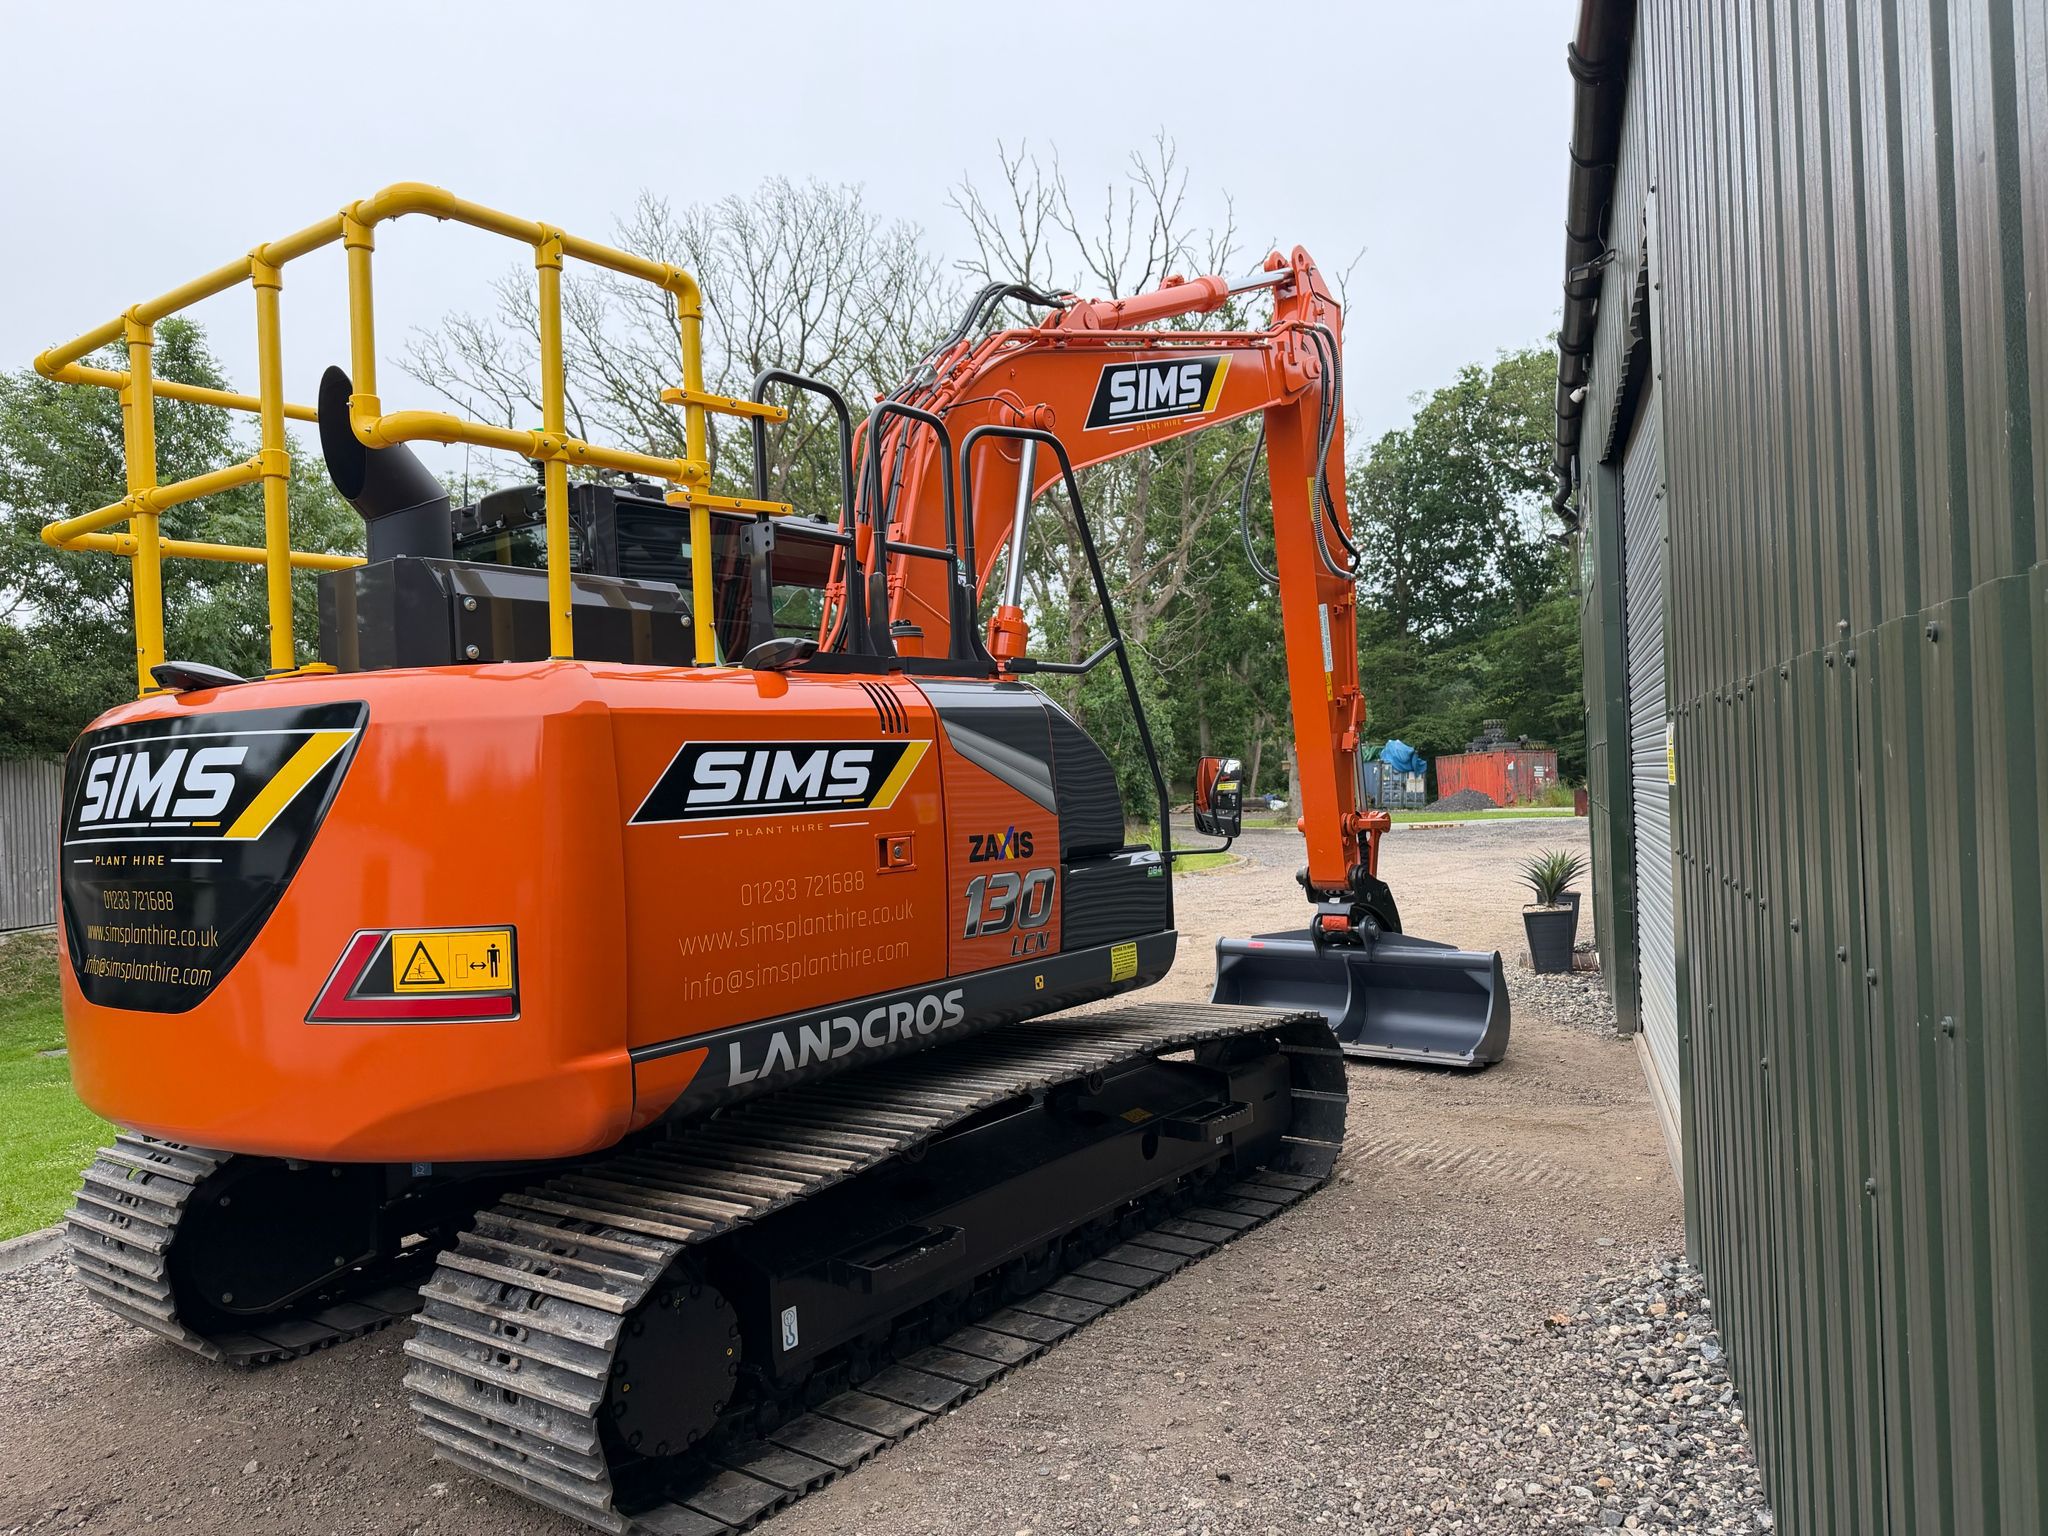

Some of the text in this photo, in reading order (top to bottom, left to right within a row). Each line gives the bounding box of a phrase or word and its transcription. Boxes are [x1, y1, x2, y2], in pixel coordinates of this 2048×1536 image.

[1109, 363, 1202, 414] SIMS
[1136, 418, 1182, 432] PLANT HIRE
[79, 746, 248, 823] SIMS
[686, 749, 874, 804] SIMS
[735, 823, 824, 837] PLANT HIRE
[968, 826, 1034, 863] ZAXIS
[95, 855, 165, 866] PLANT HIRE
[103, 890, 174, 911] 01233 721688
[741, 870, 865, 906] 01233 721688
[963, 867, 1057, 940] 130
[87, 922, 219, 947] www.simsplanthire.co.uk
[678, 899, 914, 956] www.simsplanthire.co.uk
[1010, 930, 1050, 958] LCN
[84, 954, 212, 986] info@simsplanthire.com
[684, 941, 910, 1001] info@simsplanthire.com
[728, 988, 965, 1087] LANDCROS
